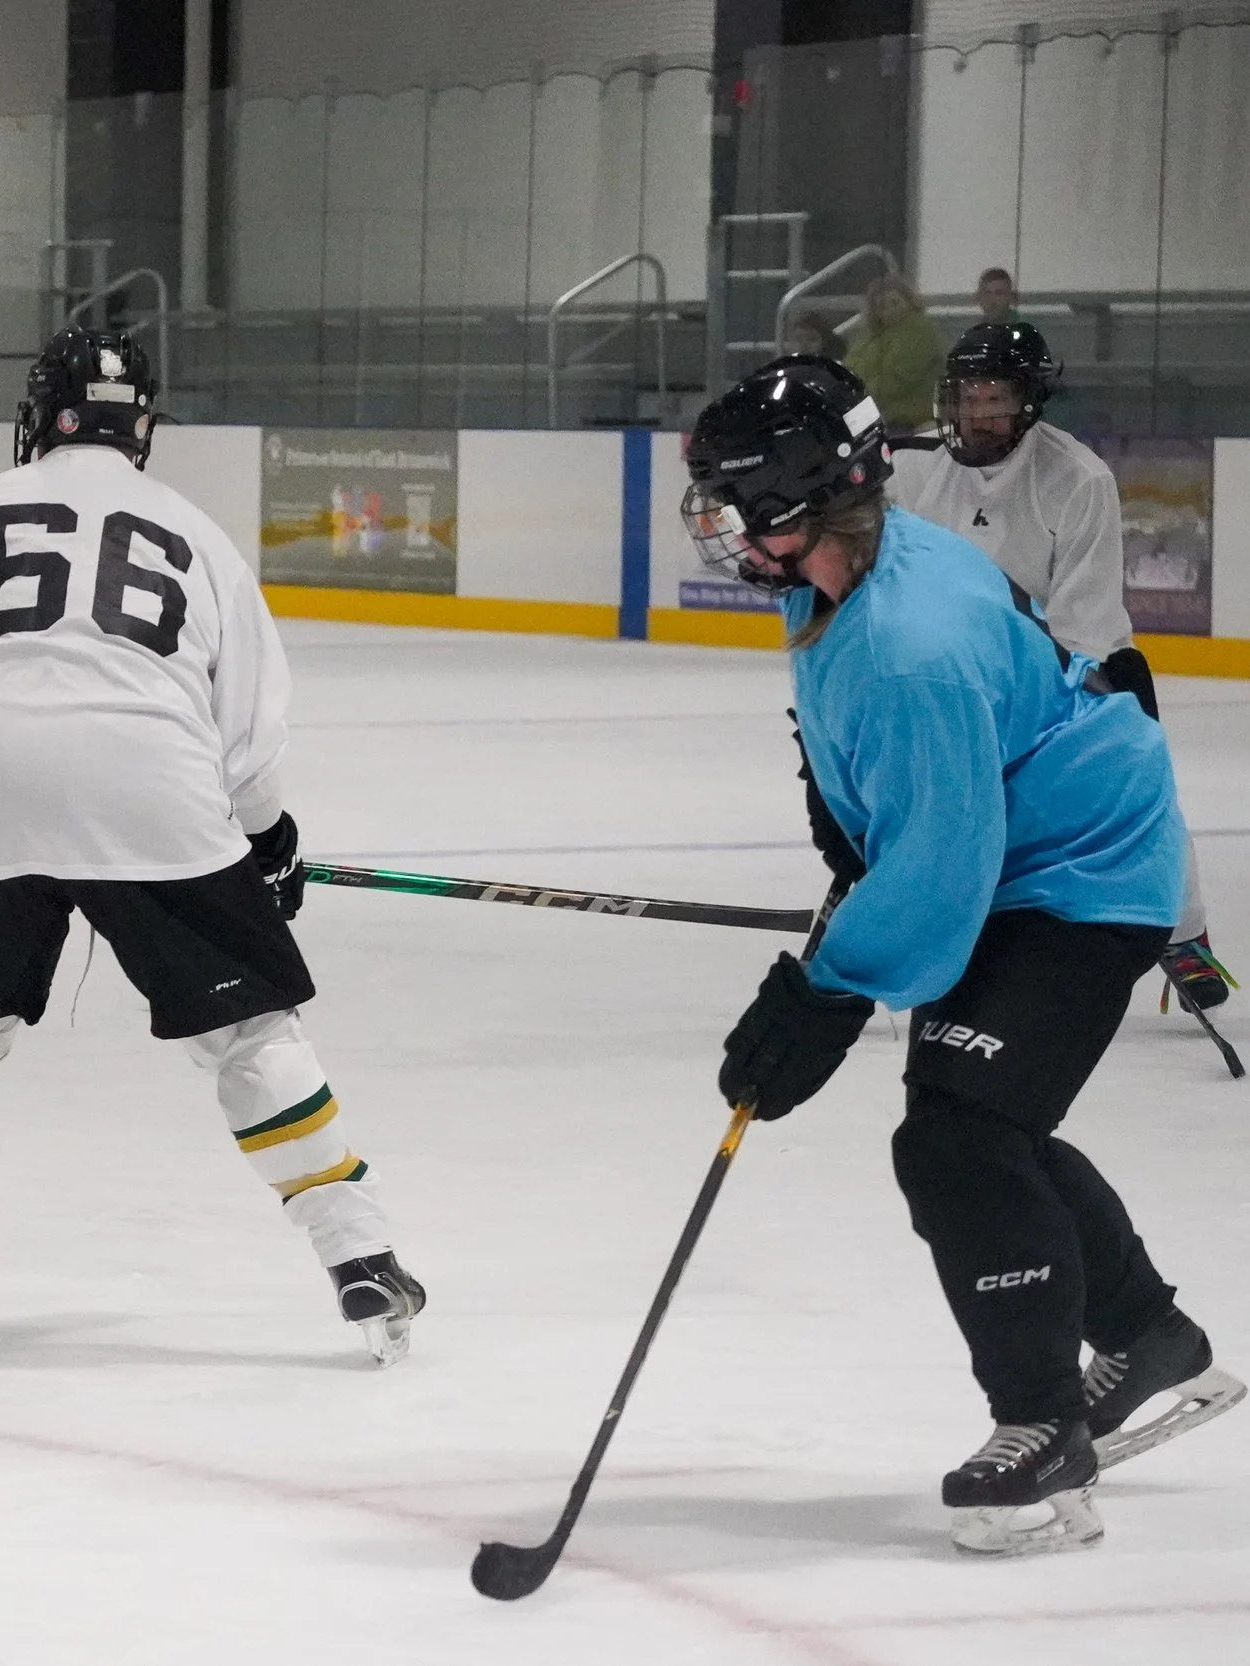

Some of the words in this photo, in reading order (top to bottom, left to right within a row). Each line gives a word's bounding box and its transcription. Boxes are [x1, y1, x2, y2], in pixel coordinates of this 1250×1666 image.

[720, 455, 764, 469] BAUER
[478, 885, 650, 917] CCM
[918, 1020, 1004, 1060] UER
[975, 1265, 1051, 1292] CCM
